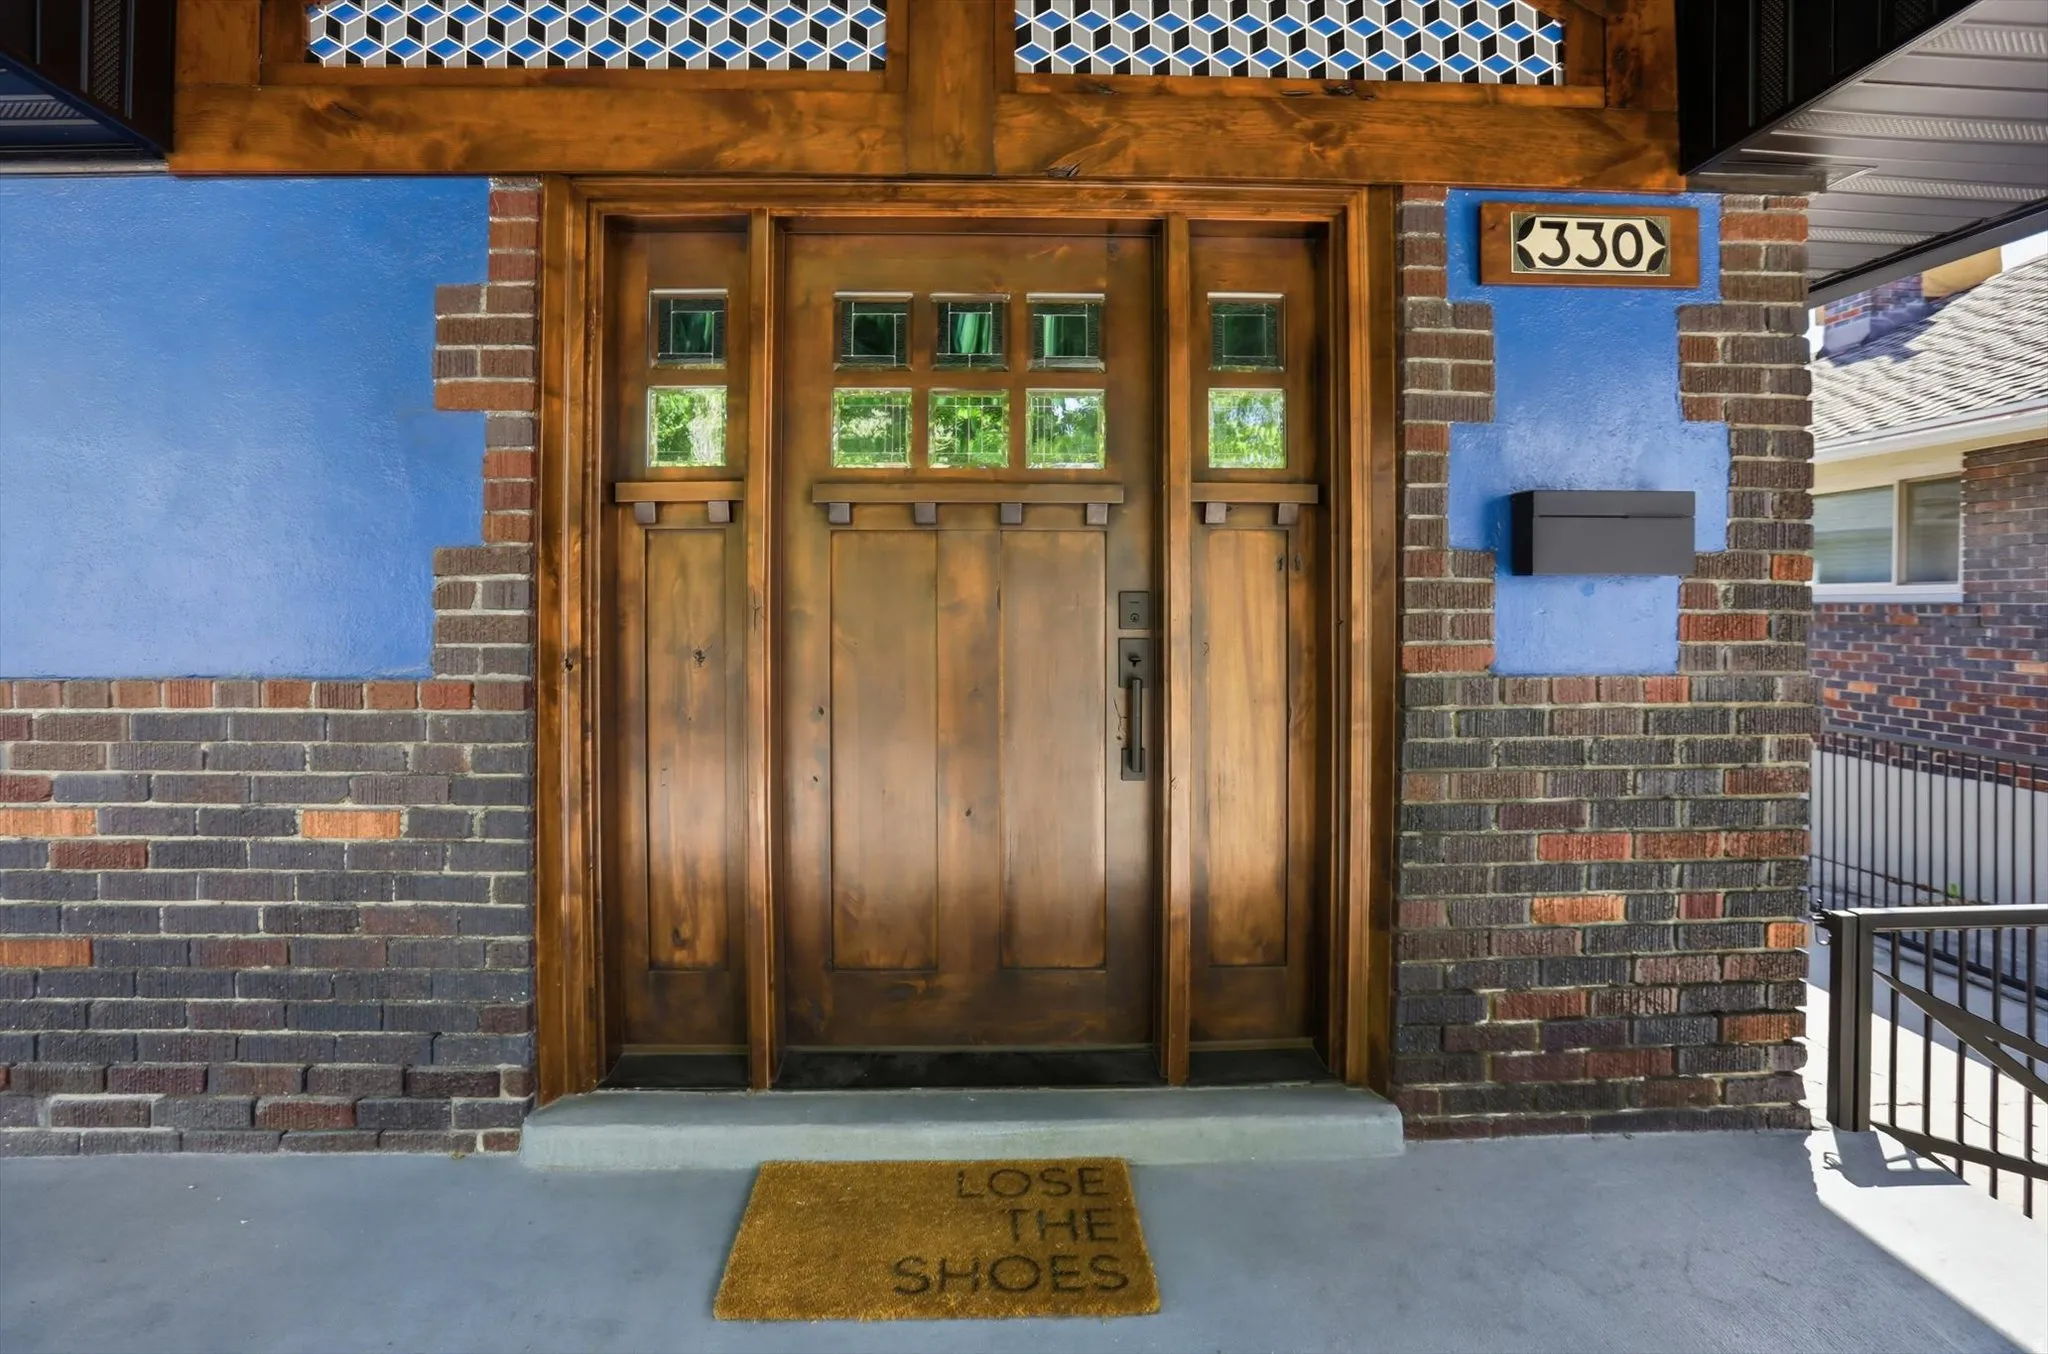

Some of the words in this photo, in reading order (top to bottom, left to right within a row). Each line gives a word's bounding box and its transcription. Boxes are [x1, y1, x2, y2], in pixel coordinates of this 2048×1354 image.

[1538, 221, 1643, 268] 330
[957, 1167, 1109, 1198] LOSE
[1002, 1208, 1118, 1242] THE
[893, 1255, 1129, 1294] SHOES
